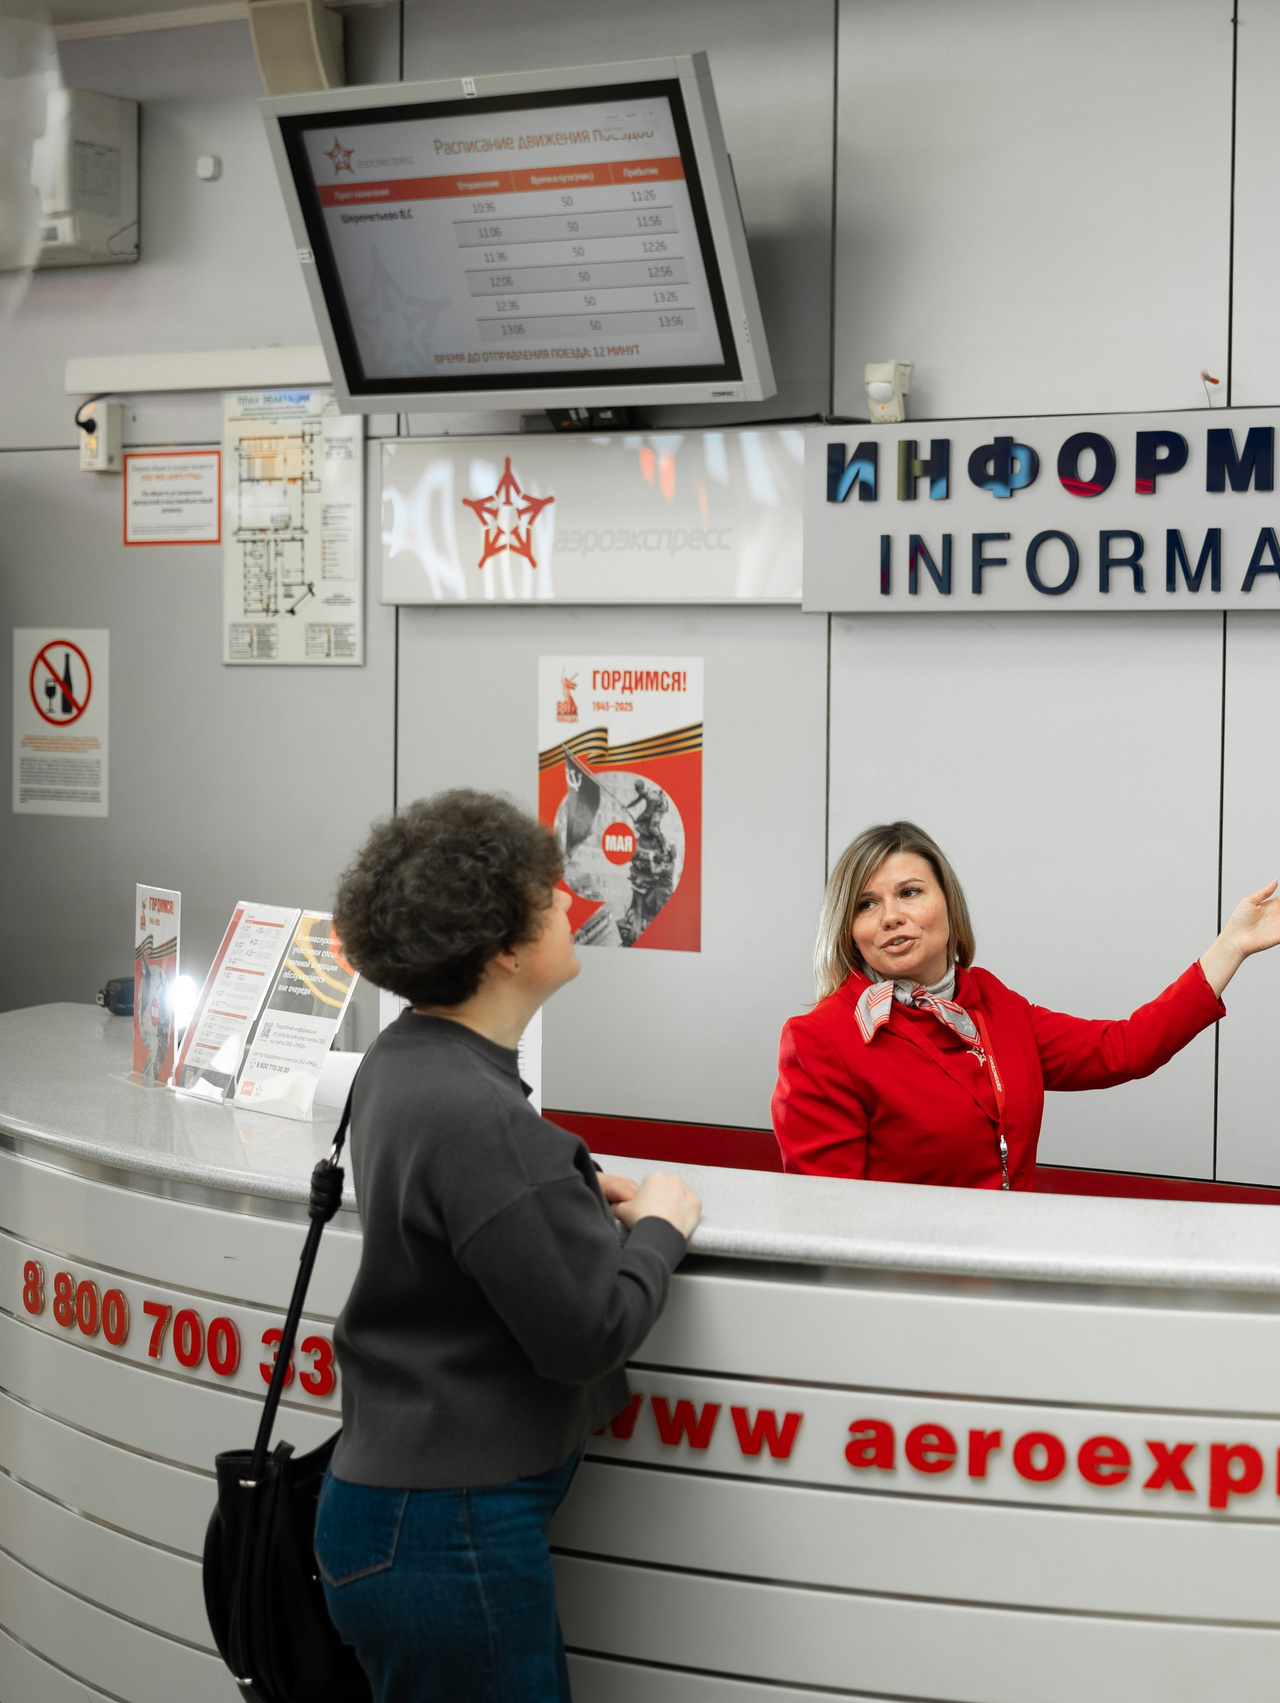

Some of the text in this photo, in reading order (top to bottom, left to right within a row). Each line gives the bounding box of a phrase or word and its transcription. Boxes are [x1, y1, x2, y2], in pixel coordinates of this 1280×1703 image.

[434, 136, 514, 156] Расписание
[518, 130, 591, 150] движения
[472, 190, 657, 214] 10:36 50 11:26
[478, 215, 662, 239] 11:06 50 11:56
[484, 241, 668, 264] 11:36 50 12:26
[490, 266, 673, 288] 12:06 50 12:56
[496, 291, 679, 312] 12:36 50 13:26
[501, 316, 684, 336] 13:06 50 13:56
[594, 346, 606, 358] 12
[552, 527, 733, 558] аэроэкспресс
[592, 670, 687, 695] ГОРДИМСЯ!
[605, 835, 633, 853] МАЯ
[23, 1260, 338, 1396] 8 800 700 33
